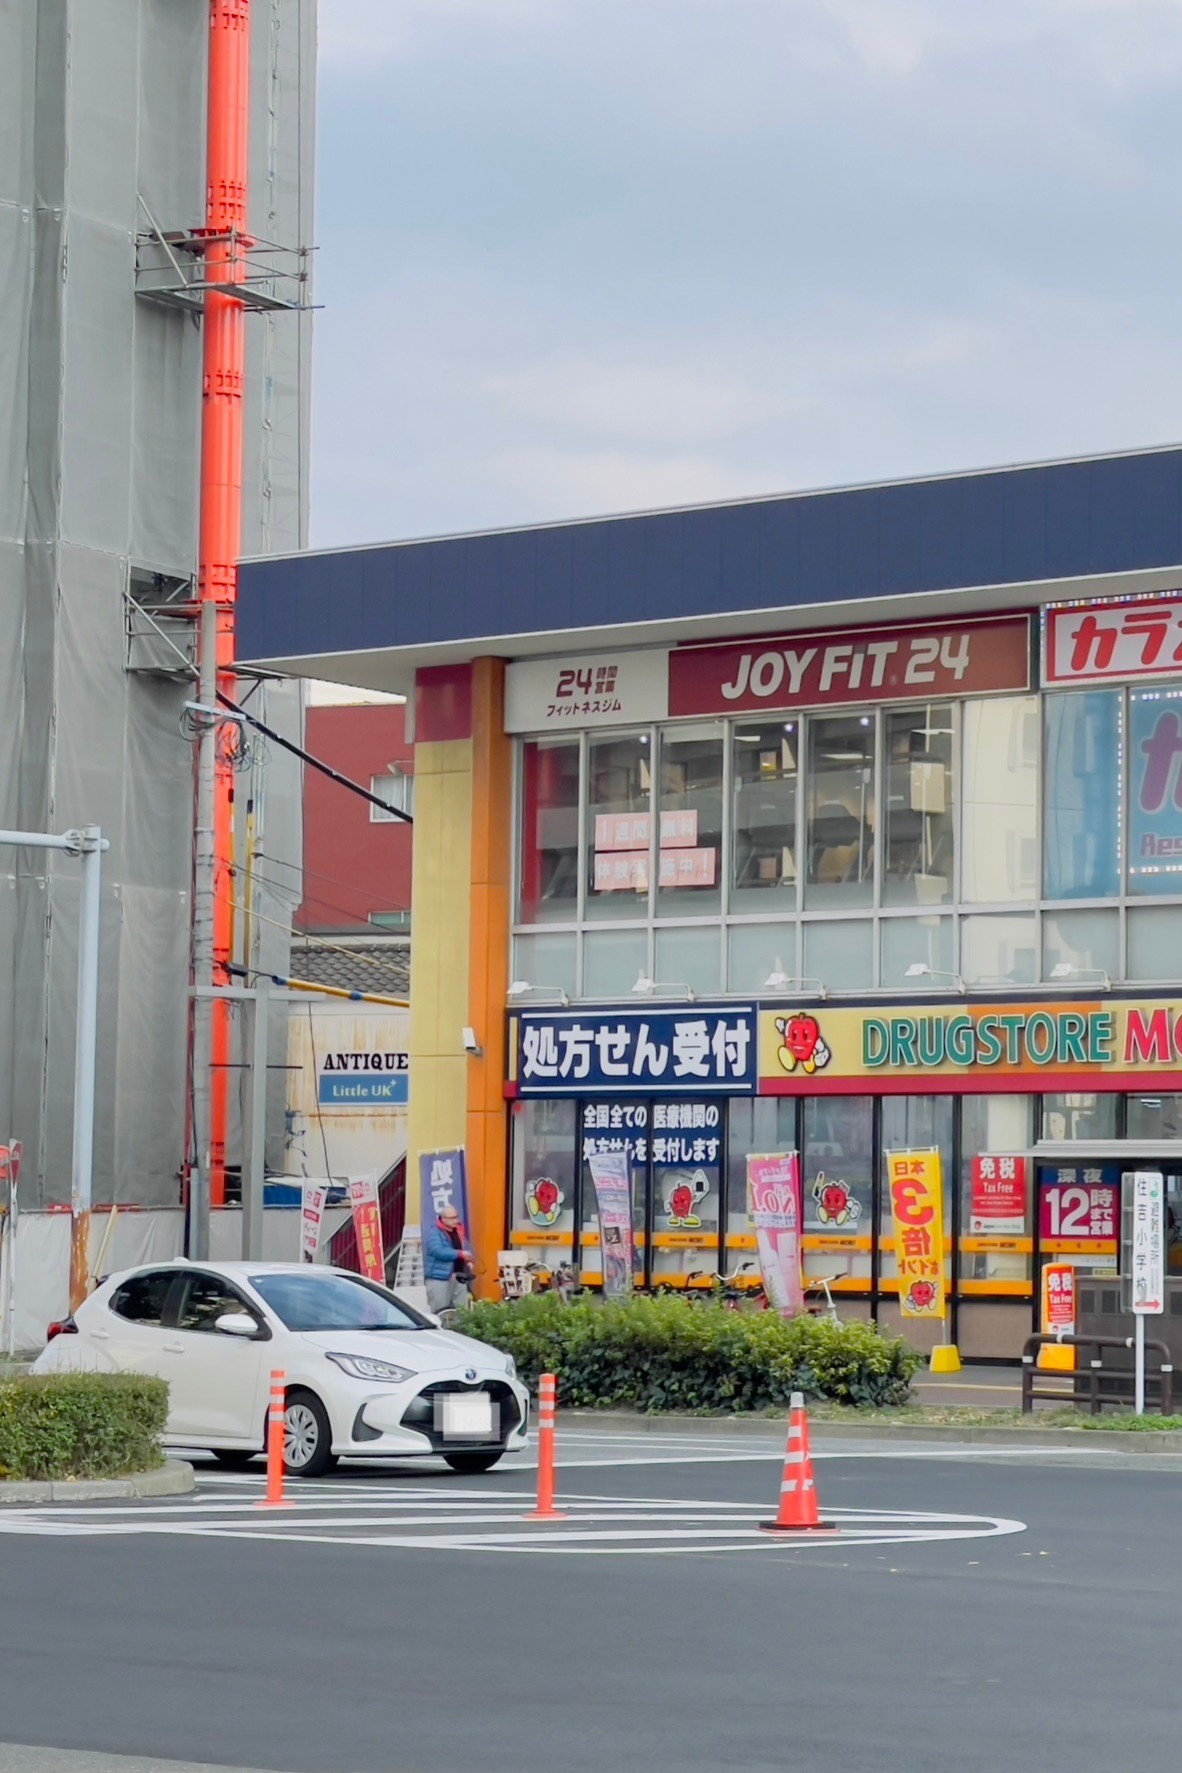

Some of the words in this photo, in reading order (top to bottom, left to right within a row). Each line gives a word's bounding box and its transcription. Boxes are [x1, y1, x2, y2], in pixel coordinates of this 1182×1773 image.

[546, 699, 621, 717] フィットネスジム
[522, 1019, 751, 1080] 処方せん受付
[861, 1010, 1116, 1069] DRUGSTORE
[323, 1053, 409, 1070] ANTIQUE
[333, 1084, 368, 1097] Little
[371, 1084, 392, 1097] UK
[583, 1104, 648, 1129] 全国全ての
[653, 1104, 719, 1129] 医療機関の
[653, 1138, 720, 1162] 受付します
[979, 1157, 1016, 1180] 免税
[1057, 1168, 1103, 1184] 深夜
[983, 1182, 996, 1193] Tax
[997, 1182, 1014, 1193] Free
[1045, 1187, 1090, 1236] 12
[1047, 1272, 1073, 1292] 免税
